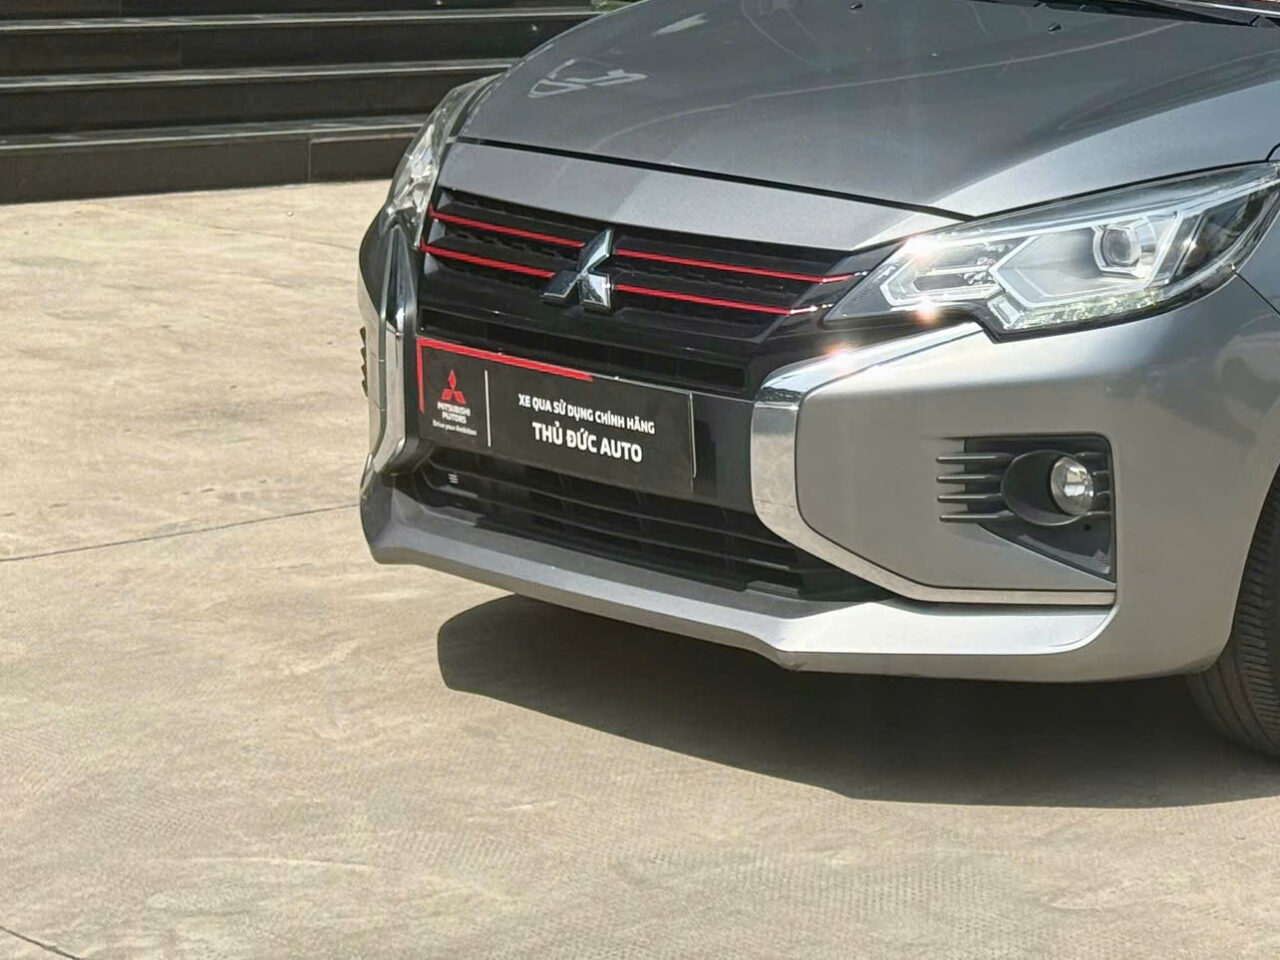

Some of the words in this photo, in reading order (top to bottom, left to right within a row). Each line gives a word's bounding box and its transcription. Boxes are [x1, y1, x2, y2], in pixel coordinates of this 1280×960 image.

[518, 393, 531, 408] XE
[532, 396, 552, 412] QUA
[553, 398, 567, 416] SỬ
[567, 404, 594, 422] DỤNG
[595, 410, 625, 429] CHÍNH
[626, 415, 656, 434] HÃNG
[532, 420, 563, 445] THỦ
[566, 427, 598, 454] ĐỨC
[599, 437, 643, 463] AUTO
